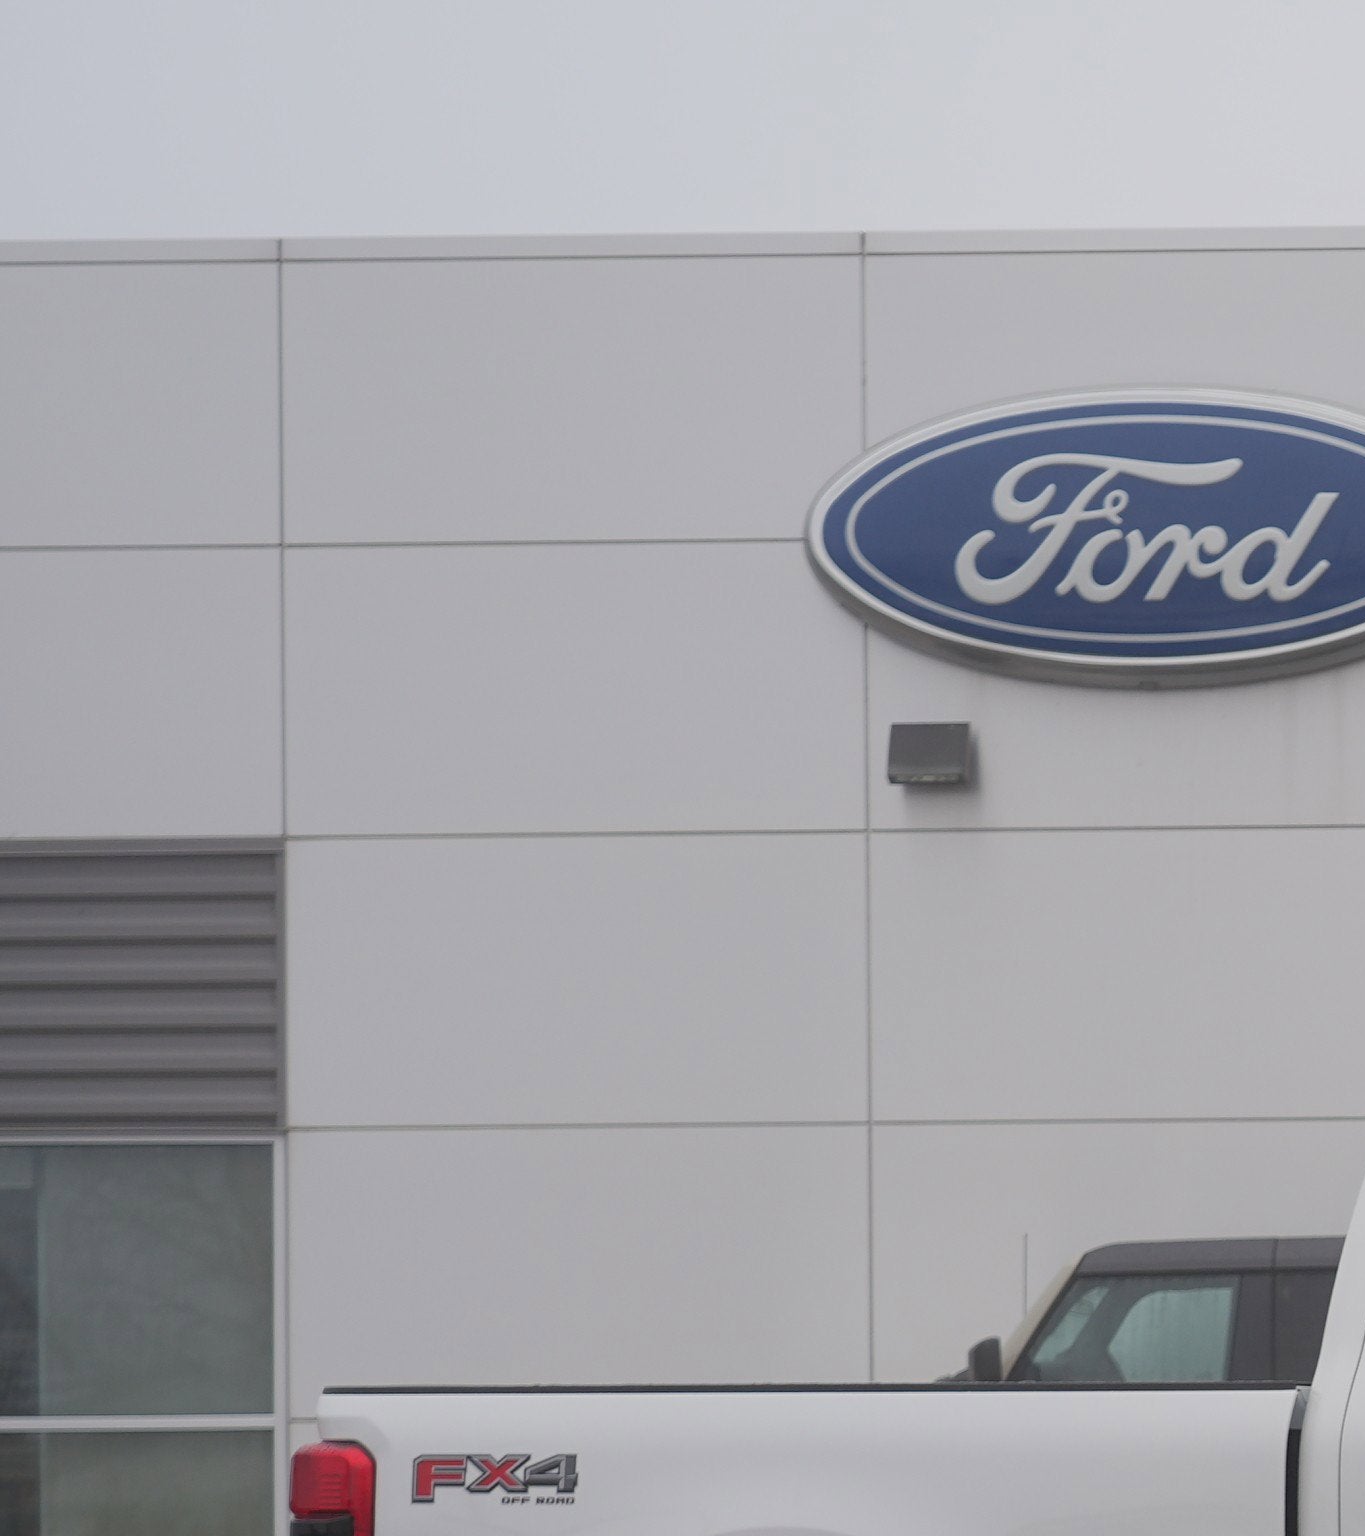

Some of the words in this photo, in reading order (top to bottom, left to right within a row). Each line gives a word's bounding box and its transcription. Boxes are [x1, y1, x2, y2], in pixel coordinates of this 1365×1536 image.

[954, 452, 1340, 604] Ford
[411, 1454, 578, 1504] FX4
[501, 1496, 531, 1505] OFF
[536, 1496, 576, 1505] ROAD
